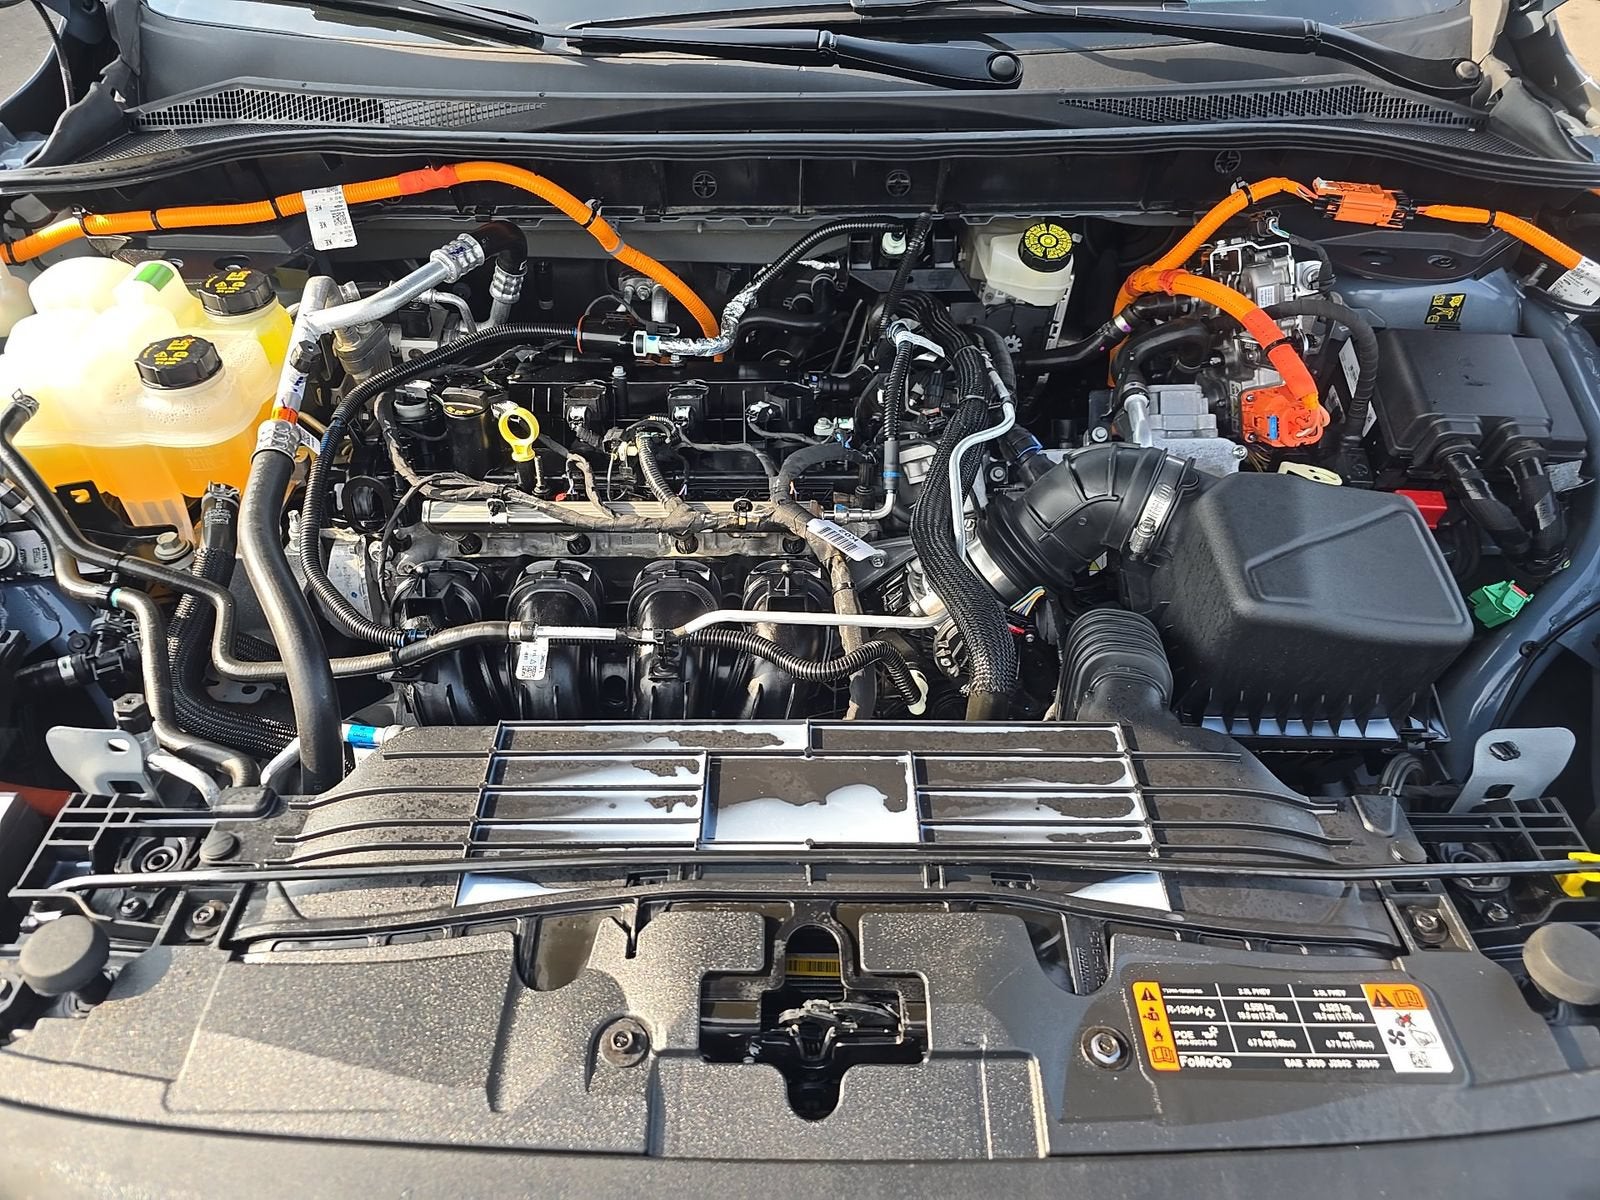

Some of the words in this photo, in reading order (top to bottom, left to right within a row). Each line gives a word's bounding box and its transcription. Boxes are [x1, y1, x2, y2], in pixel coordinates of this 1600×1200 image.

[1166, 1004, 1203, 1016] R-1234yf
[1174, 1031, 1196, 1039] POE
[1179, 1055, 1232, 1069] FoMoCo
